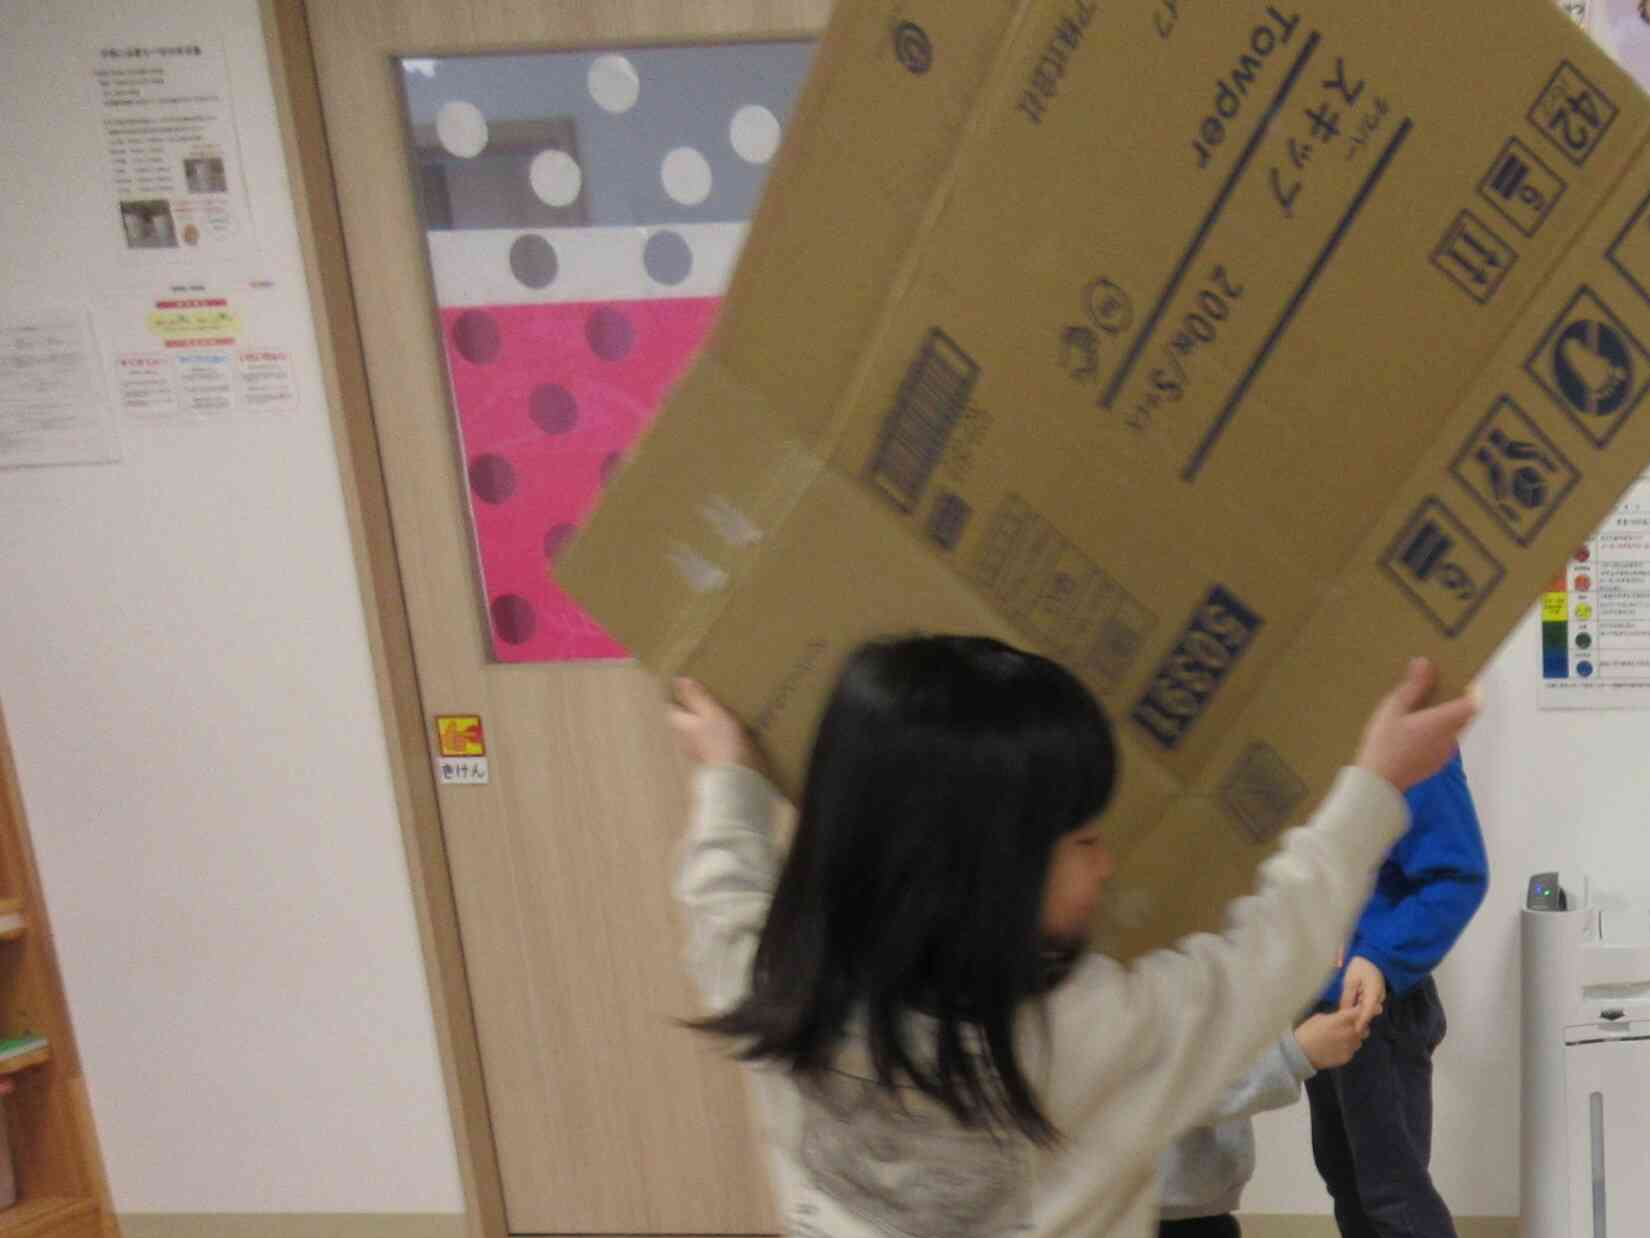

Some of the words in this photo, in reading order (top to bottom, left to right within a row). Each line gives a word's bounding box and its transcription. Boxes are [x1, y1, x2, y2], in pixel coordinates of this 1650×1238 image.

[1189, 5, 1302, 171] Towper
[1266, 57, 1369, 219] スキップ
[1545, 84, 1611, 153] 42
[441, 762, 485, 780] きけん
